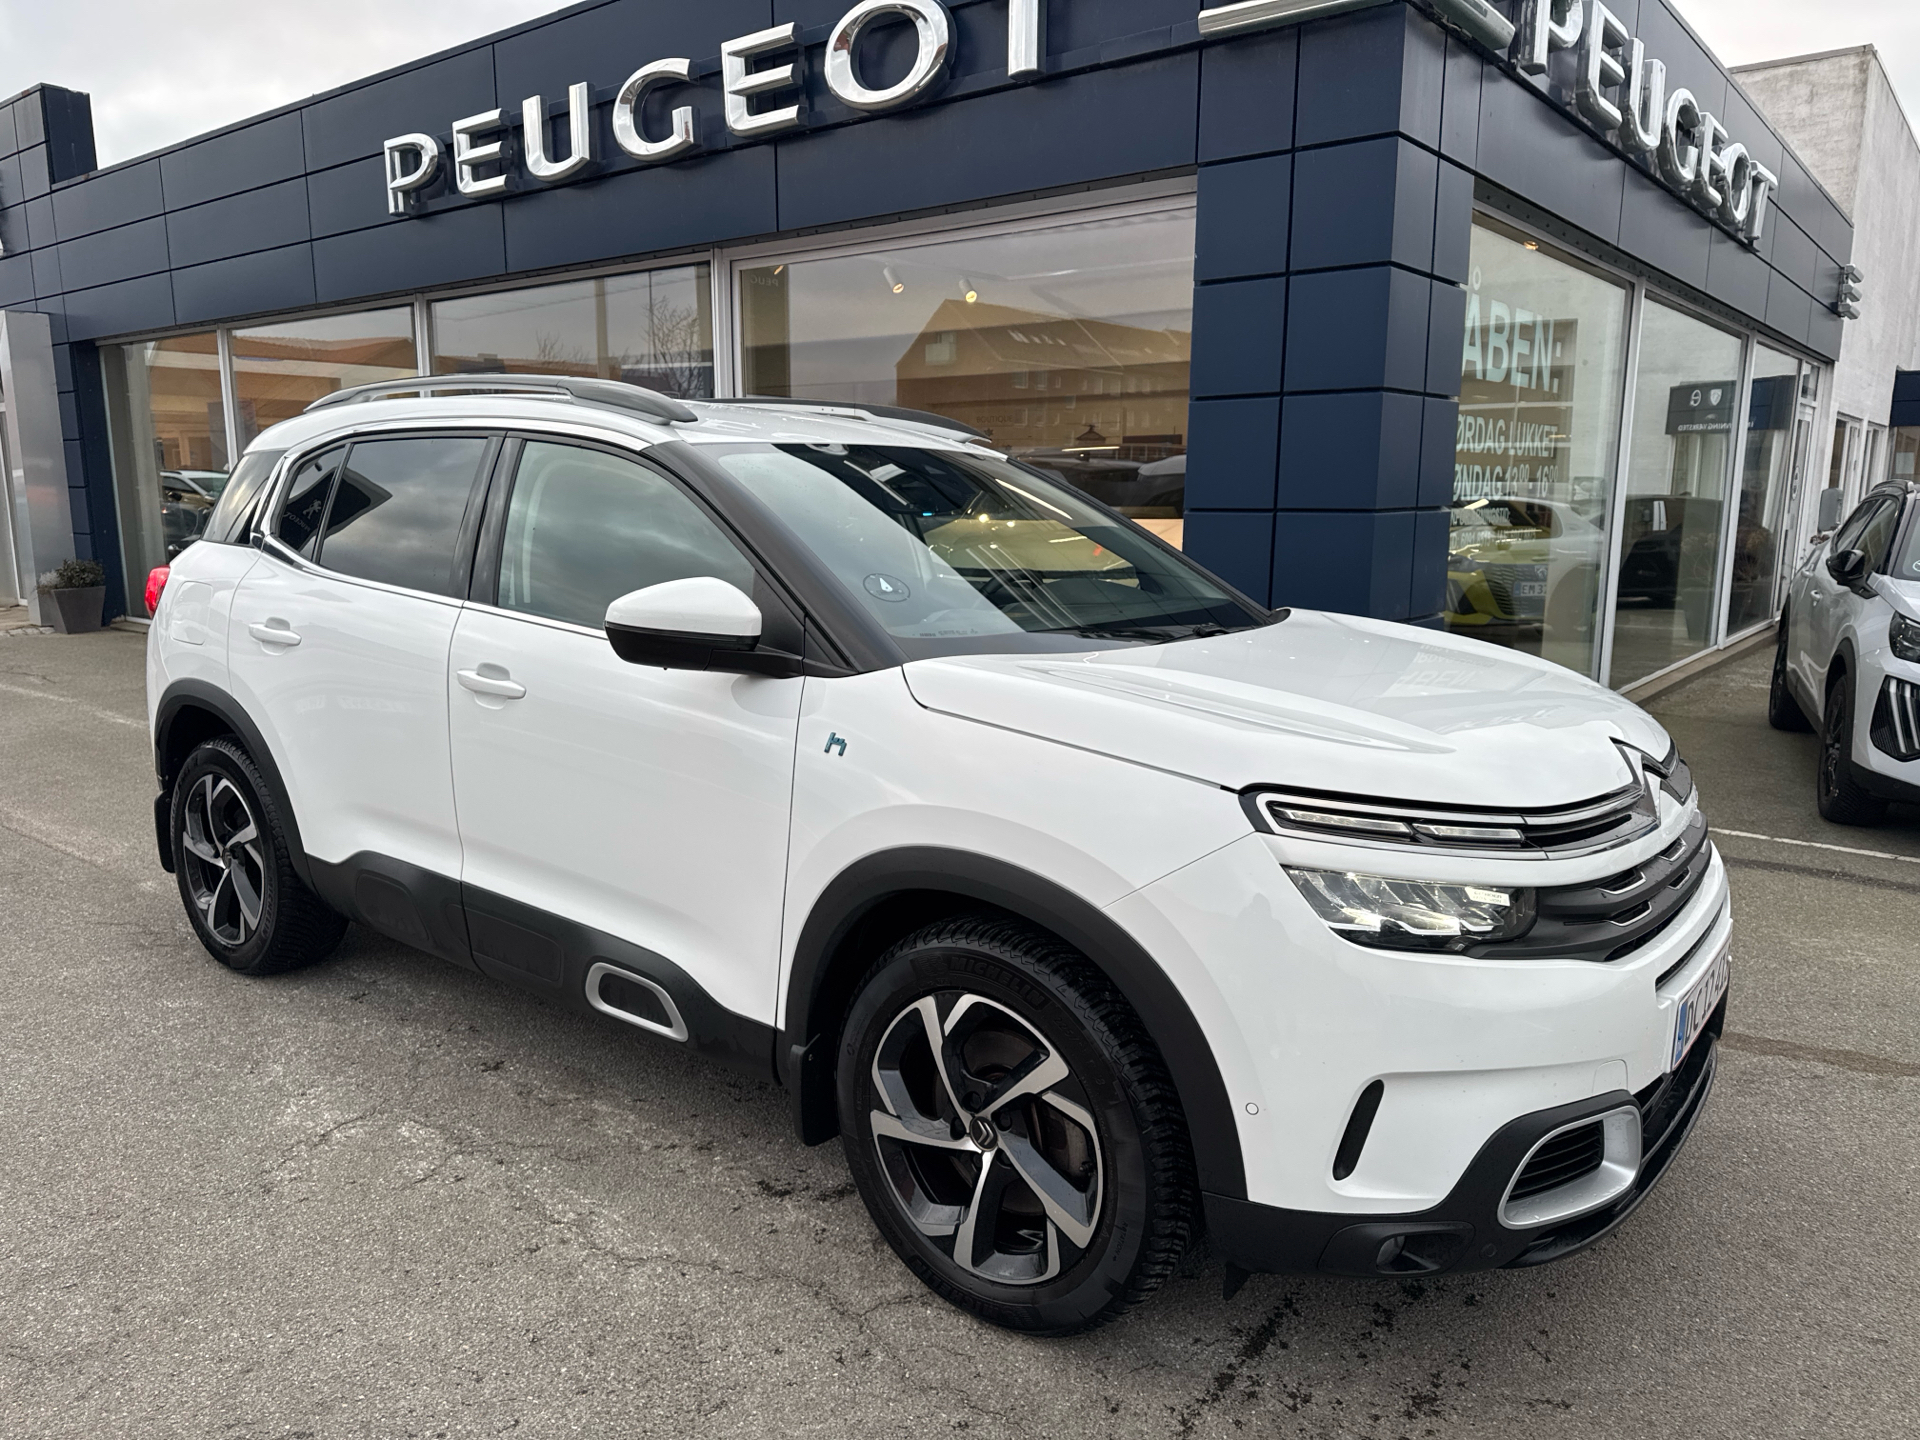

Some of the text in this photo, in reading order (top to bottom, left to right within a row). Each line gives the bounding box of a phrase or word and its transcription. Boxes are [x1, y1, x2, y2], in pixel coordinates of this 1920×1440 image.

[1519, 0, 1778, 240] PEUGEOT
[1509, 421, 1558, 457] LUKKET
[950, 957, 1046, 1009] MICHELIN
